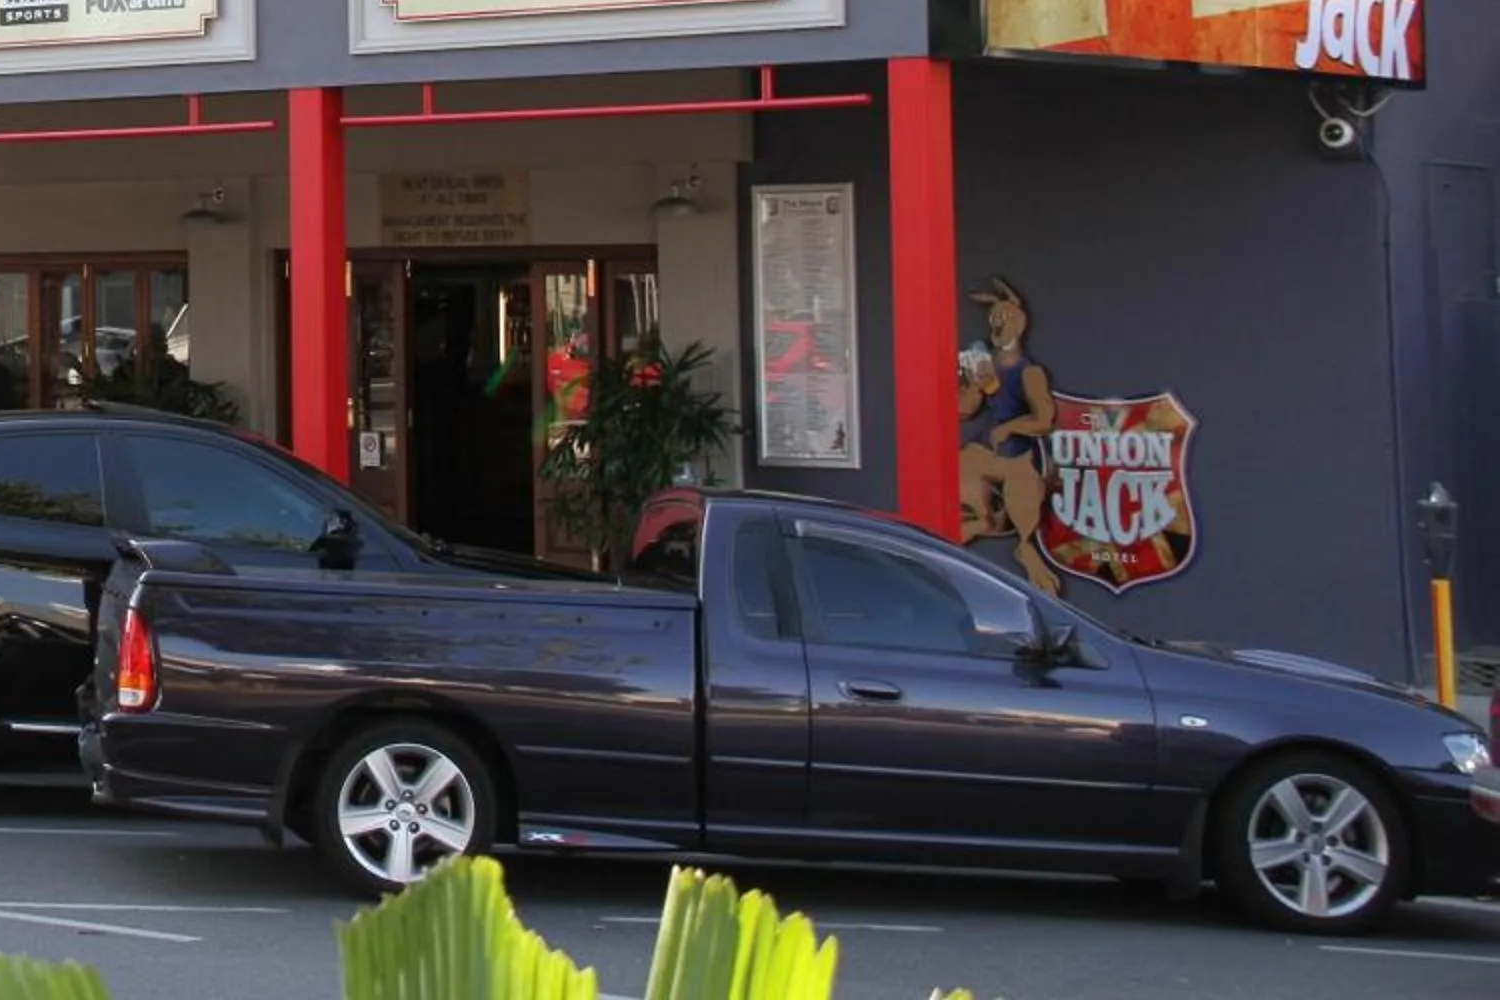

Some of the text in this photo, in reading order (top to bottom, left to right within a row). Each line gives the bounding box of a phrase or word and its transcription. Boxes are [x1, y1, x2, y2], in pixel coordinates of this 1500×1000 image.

[5, 7, 62, 22] SPORTS
[1051, 431, 1173, 468] UNION
[1051, 467, 1176, 546] JACK
[1091, 552, 1138, 564] HOTEL
